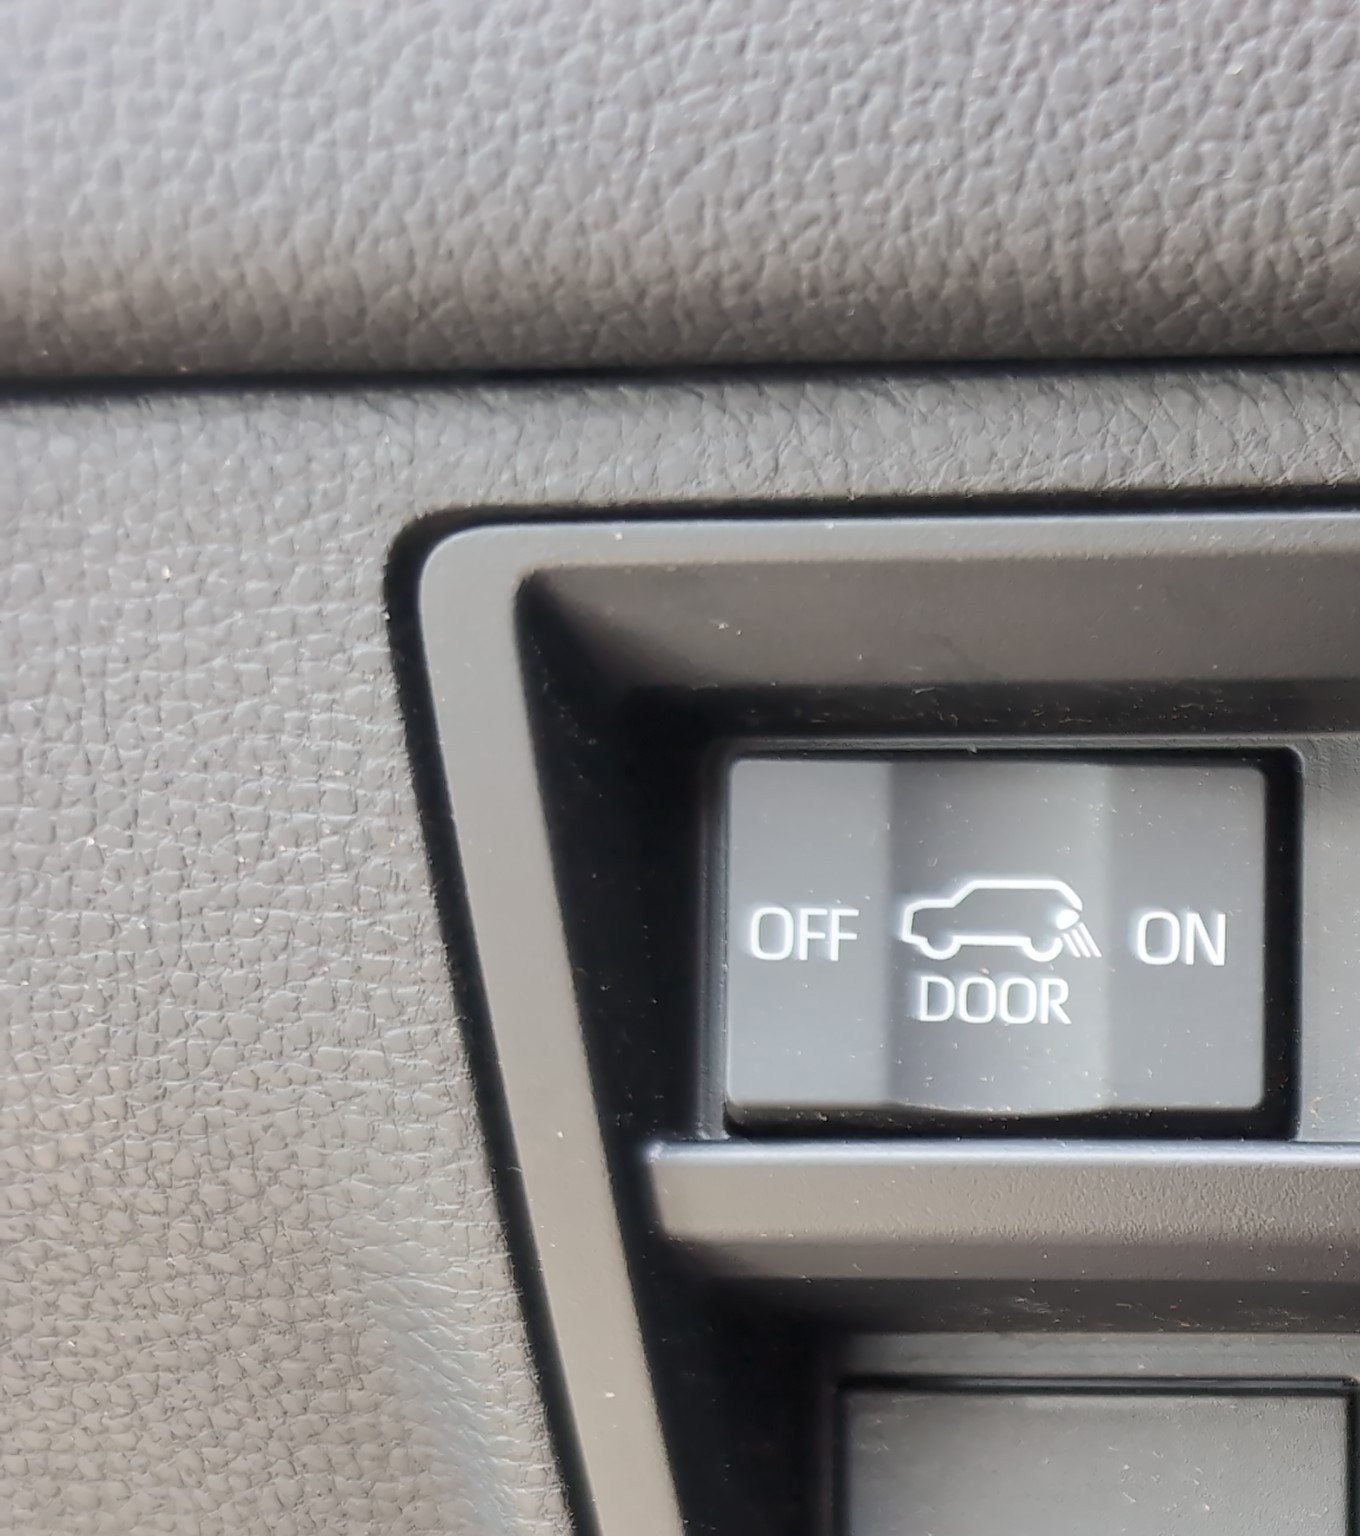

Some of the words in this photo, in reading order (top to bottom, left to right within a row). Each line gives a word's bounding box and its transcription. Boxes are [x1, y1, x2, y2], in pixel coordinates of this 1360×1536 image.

[748, 906, 860, 962] OFF
[1134, 910, 1226, 966] ON
[918, 975, 1072, 1025] DOOR
